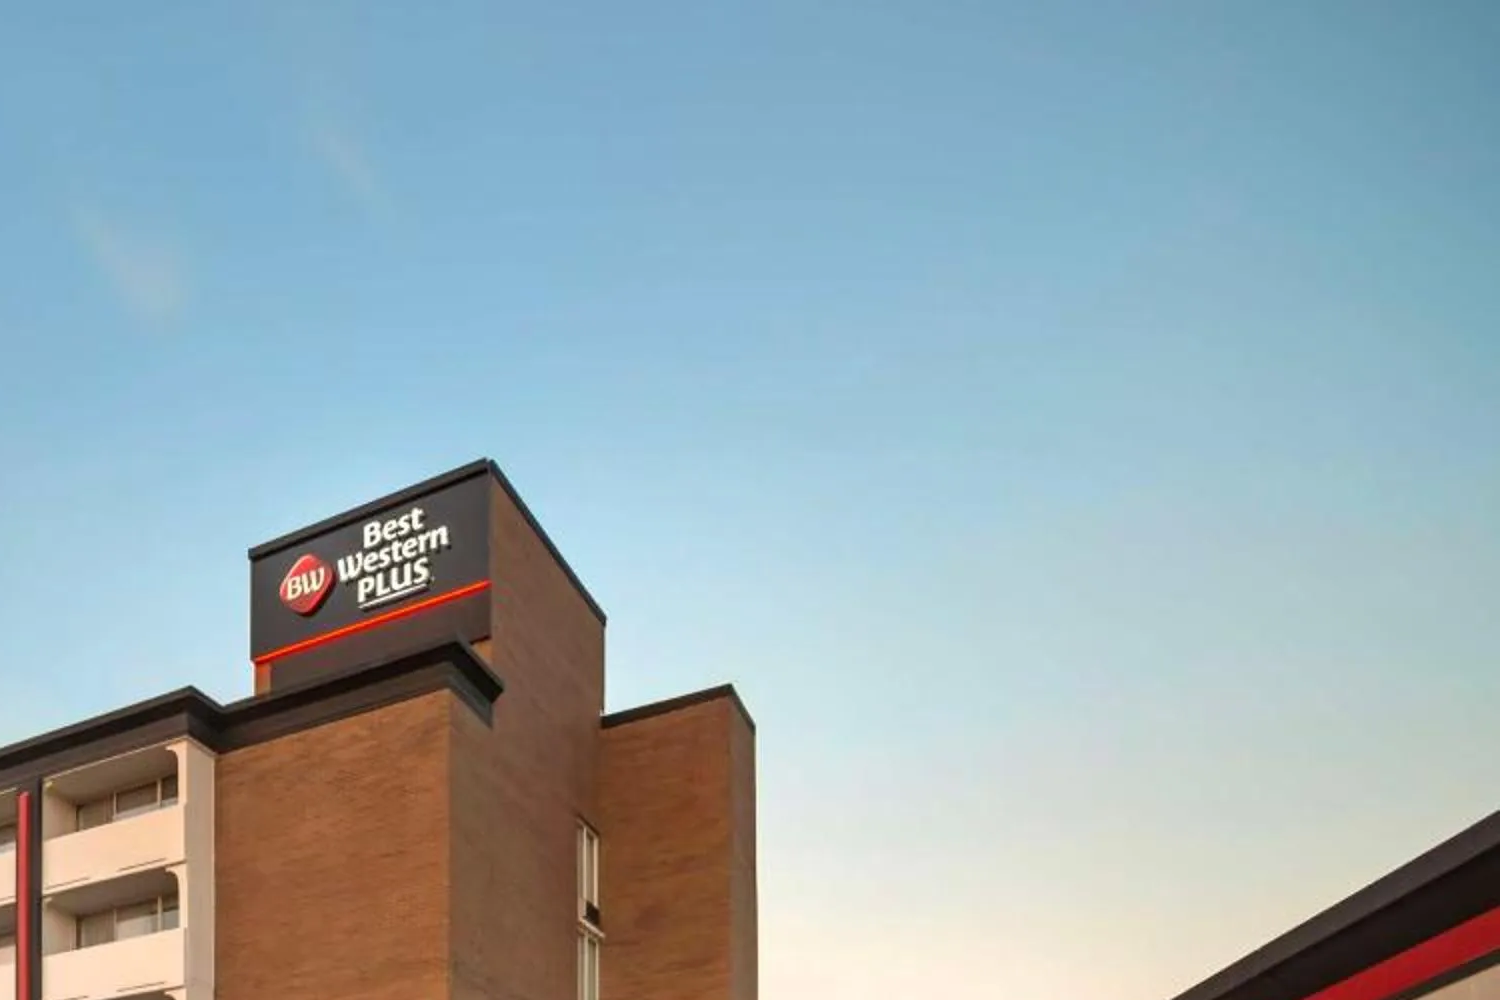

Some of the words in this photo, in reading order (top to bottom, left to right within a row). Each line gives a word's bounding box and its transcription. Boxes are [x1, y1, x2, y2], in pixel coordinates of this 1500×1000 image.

[363, 507, 425, 549] Best
[337, 525, 449, 582] Western
[286, 566, 325, 601] BW
[357, 557, 431, 603] PLUS
